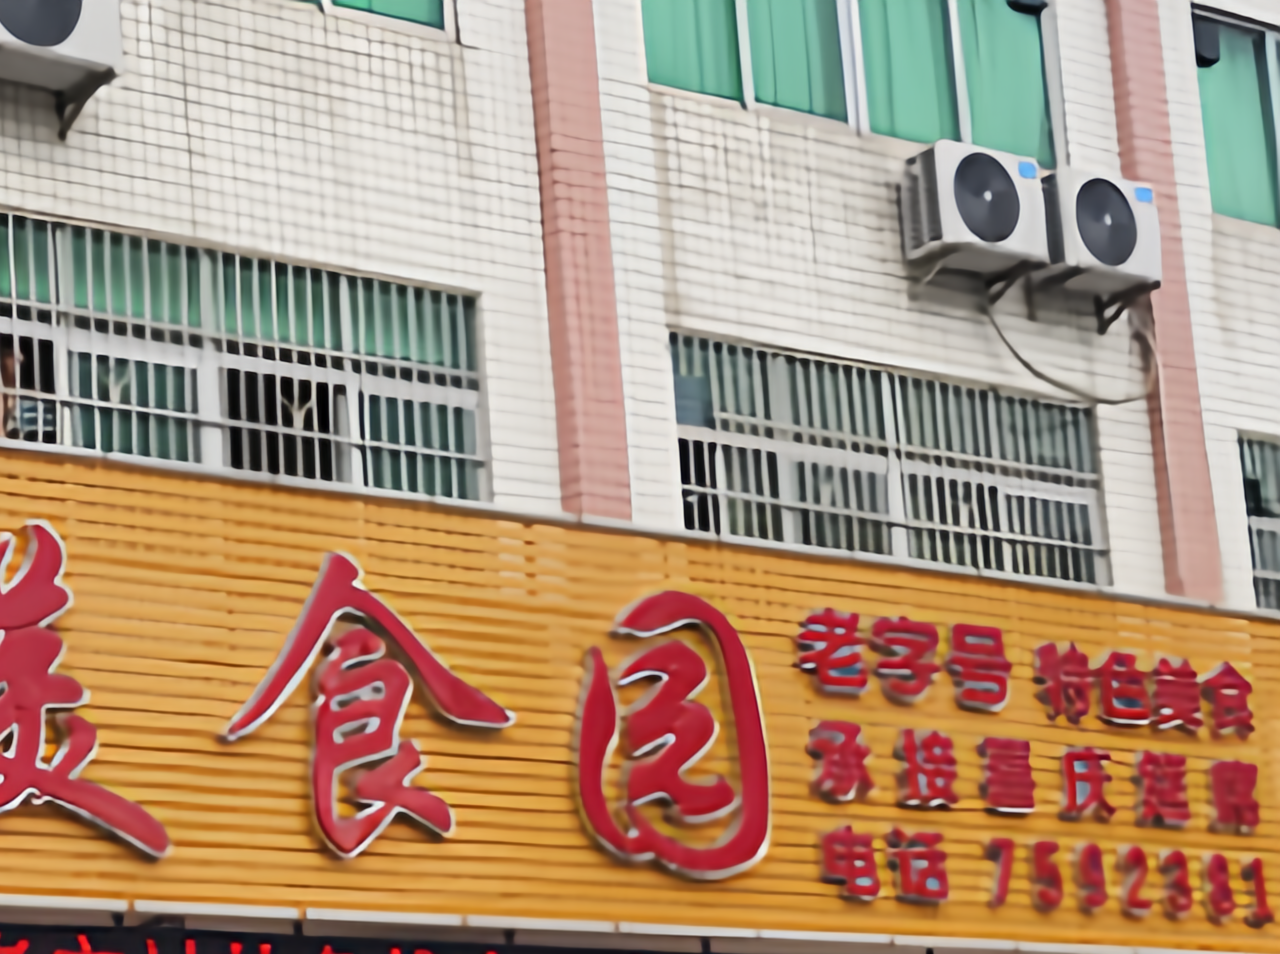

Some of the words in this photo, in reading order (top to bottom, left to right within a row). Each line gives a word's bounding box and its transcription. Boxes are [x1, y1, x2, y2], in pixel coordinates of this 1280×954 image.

[794, 606, 1012, 714] 老字号
[1032, 640, 1257, 740] 特色美食
[819, 825, 950, 904] 电话
